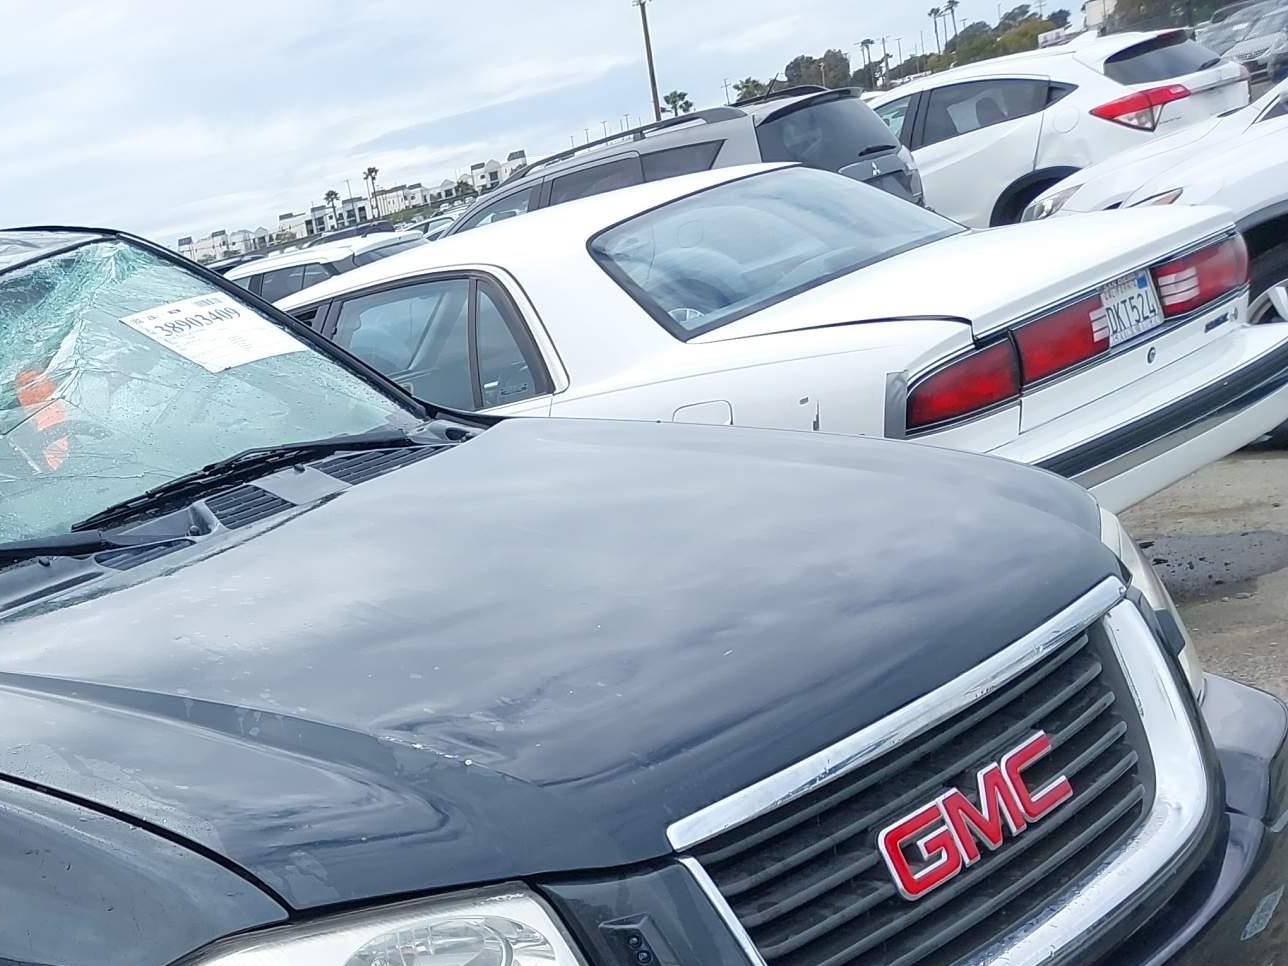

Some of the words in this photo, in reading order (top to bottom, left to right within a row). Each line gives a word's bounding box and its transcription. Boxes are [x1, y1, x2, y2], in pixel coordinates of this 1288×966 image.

[154, 305, 241, 337] 38903409
[1105, 289, 1157, 334] DKT524
[878, 729, 1073, 901] GMC
